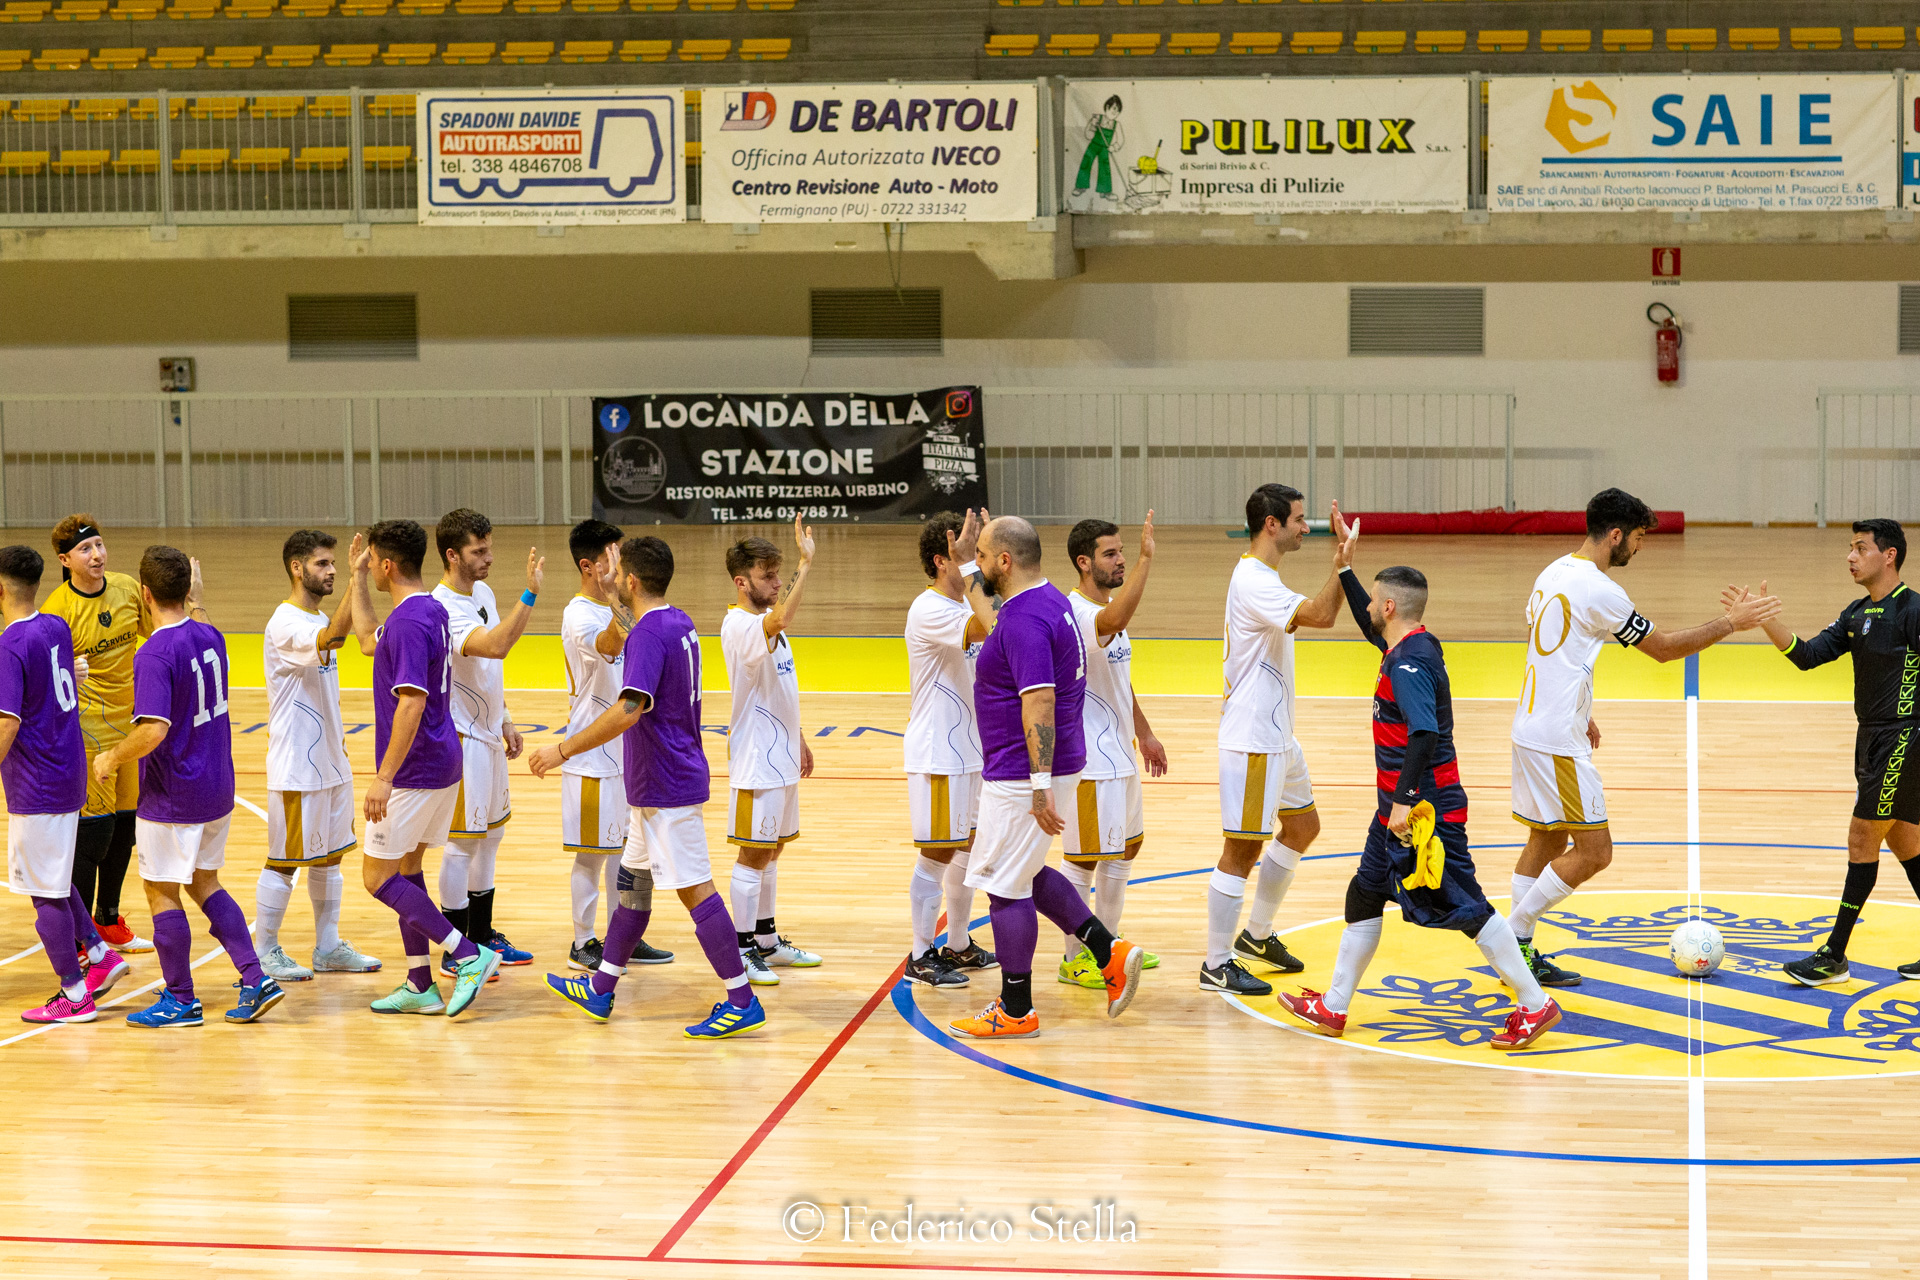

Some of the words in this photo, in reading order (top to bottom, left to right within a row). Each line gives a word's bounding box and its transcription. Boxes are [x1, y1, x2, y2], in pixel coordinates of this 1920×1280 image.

[440, 113, 514, 128] SPADONI
[519, 112, 581, 128] DAVIDE
[788, 100, 843, 132] DE
[851, 98, 1018, 132] BARTOLI
[1651, 93, 1832, 146] SAIE
[442, 134, 580, 152] AUTOTRASPORTI
[1180, 118, 1416, 155] PULILUX
[1425, 144, 1452, 152] S.a.s.
[441, 159, 466, 173] tel.
[472, 158, 503, 173] 338
[508, 158, 582, 173] 4846708
[731, 148, 807, 171] Officina
[812, 148, 925, 166] Autorizzata
[931, 146, 1001, 166] IVECO
[1180, 162, 1188, 171] di
[1191, 161, 1217, 170] Sorini
[1220, 162, 1246, 170] Brivio
[1260, 162, 1270, 170] C.
[1539, 170, 1598, 179] SBANCAMENTI
[1603, 170, 1671, 178] AUTOTRASPORTI
[1676, 169, 1725, 178] FOGNATURE
[1731, 169, 1785, 178] ACQUEDOTTI
[1790, 169, 1845, 177] ESCAVAZIONI
[732, 179, 791, 196] Centro
[796, 178, 880, 195] Revisione
[888, 178, 933, 194] Auto
[949, 178, 999, 194] Moto
[1181, 178, 1254, 198] Impresa
[1260, 177, 1277, 193] di
[1284, 177, 1345, 193] Pulizie
[1497, 185, 1524, 195] SAIE
[1527, 187, 1546, 195] snc
[1548, 185, 1558, 194] di
[1560, 184, 1601, 194] Annibali
[1604, 184, 1646, 194] Roberto
[1649, 184, 1701, 194] Iacomucci
[1704, 185, 1712, 194] P.
[1716, 184, 1773, 194] Bartolomei
[1776, 184, 1788, 194] M.
[1792, 183, 1839, 194] Pascucci
[1842, 183, 1852, 193] E.
[1856, 183, 1863, 193] &
[1867, 183, 1878, 193] C.
[1498, 197, 1514, 207] Via
[1517, 197, 1538, 207] Del
[1540, 197, 1576, 208] Lavoro,
[1579, 197, 1592, 207] 30
[1602, 197, 1635, 207] 61030
[1637, 197, 1698, 207] Canavaccio
[1701, 197, 1711, 206] di
[1713, 196, 1749, 207] Urbino
[1759, 196, 1773, 206] Tel.
[1816, 195, 1842, 206] 0722
[1845, 195, 1879, 206] 53195
[428, 210, 478, 218] Autotrasporti
[480, 210, 511, 219] Spadoni
[618, 206, 657, 216] RICCIONE
[660, 205, 677, 217] (RN)
[759, 204, 838, 219] Fermignano
[841, 203, 869, 218] (PU)
[880, 202, 914, 215] 0722
[918, 202, 967, 215] 331342
[643, 400, 815, 428] LOCANDA
[824, 399, 930, 427] DELLA
[928, 443, 968, 458] ITALIAN
[701, 449, 873, 476] STAZIONE
[935, 459, 965, 471] PIZZA
[666, 485, 764, 500] RISTORANTE
[768, 484, 841, 499] PIZZERIA
[845, 482, 909, 497] URBINO
[711, 508, 738, 520] TEL
[777, 506, 796, 518] 03
[800, 506, 828, 518] 788
[832, 505, 848, 518] 71
[1632, 615, 1647, 631] C
[51, 645, 76, 712] 6
[191, 648, 228, 727] 11
